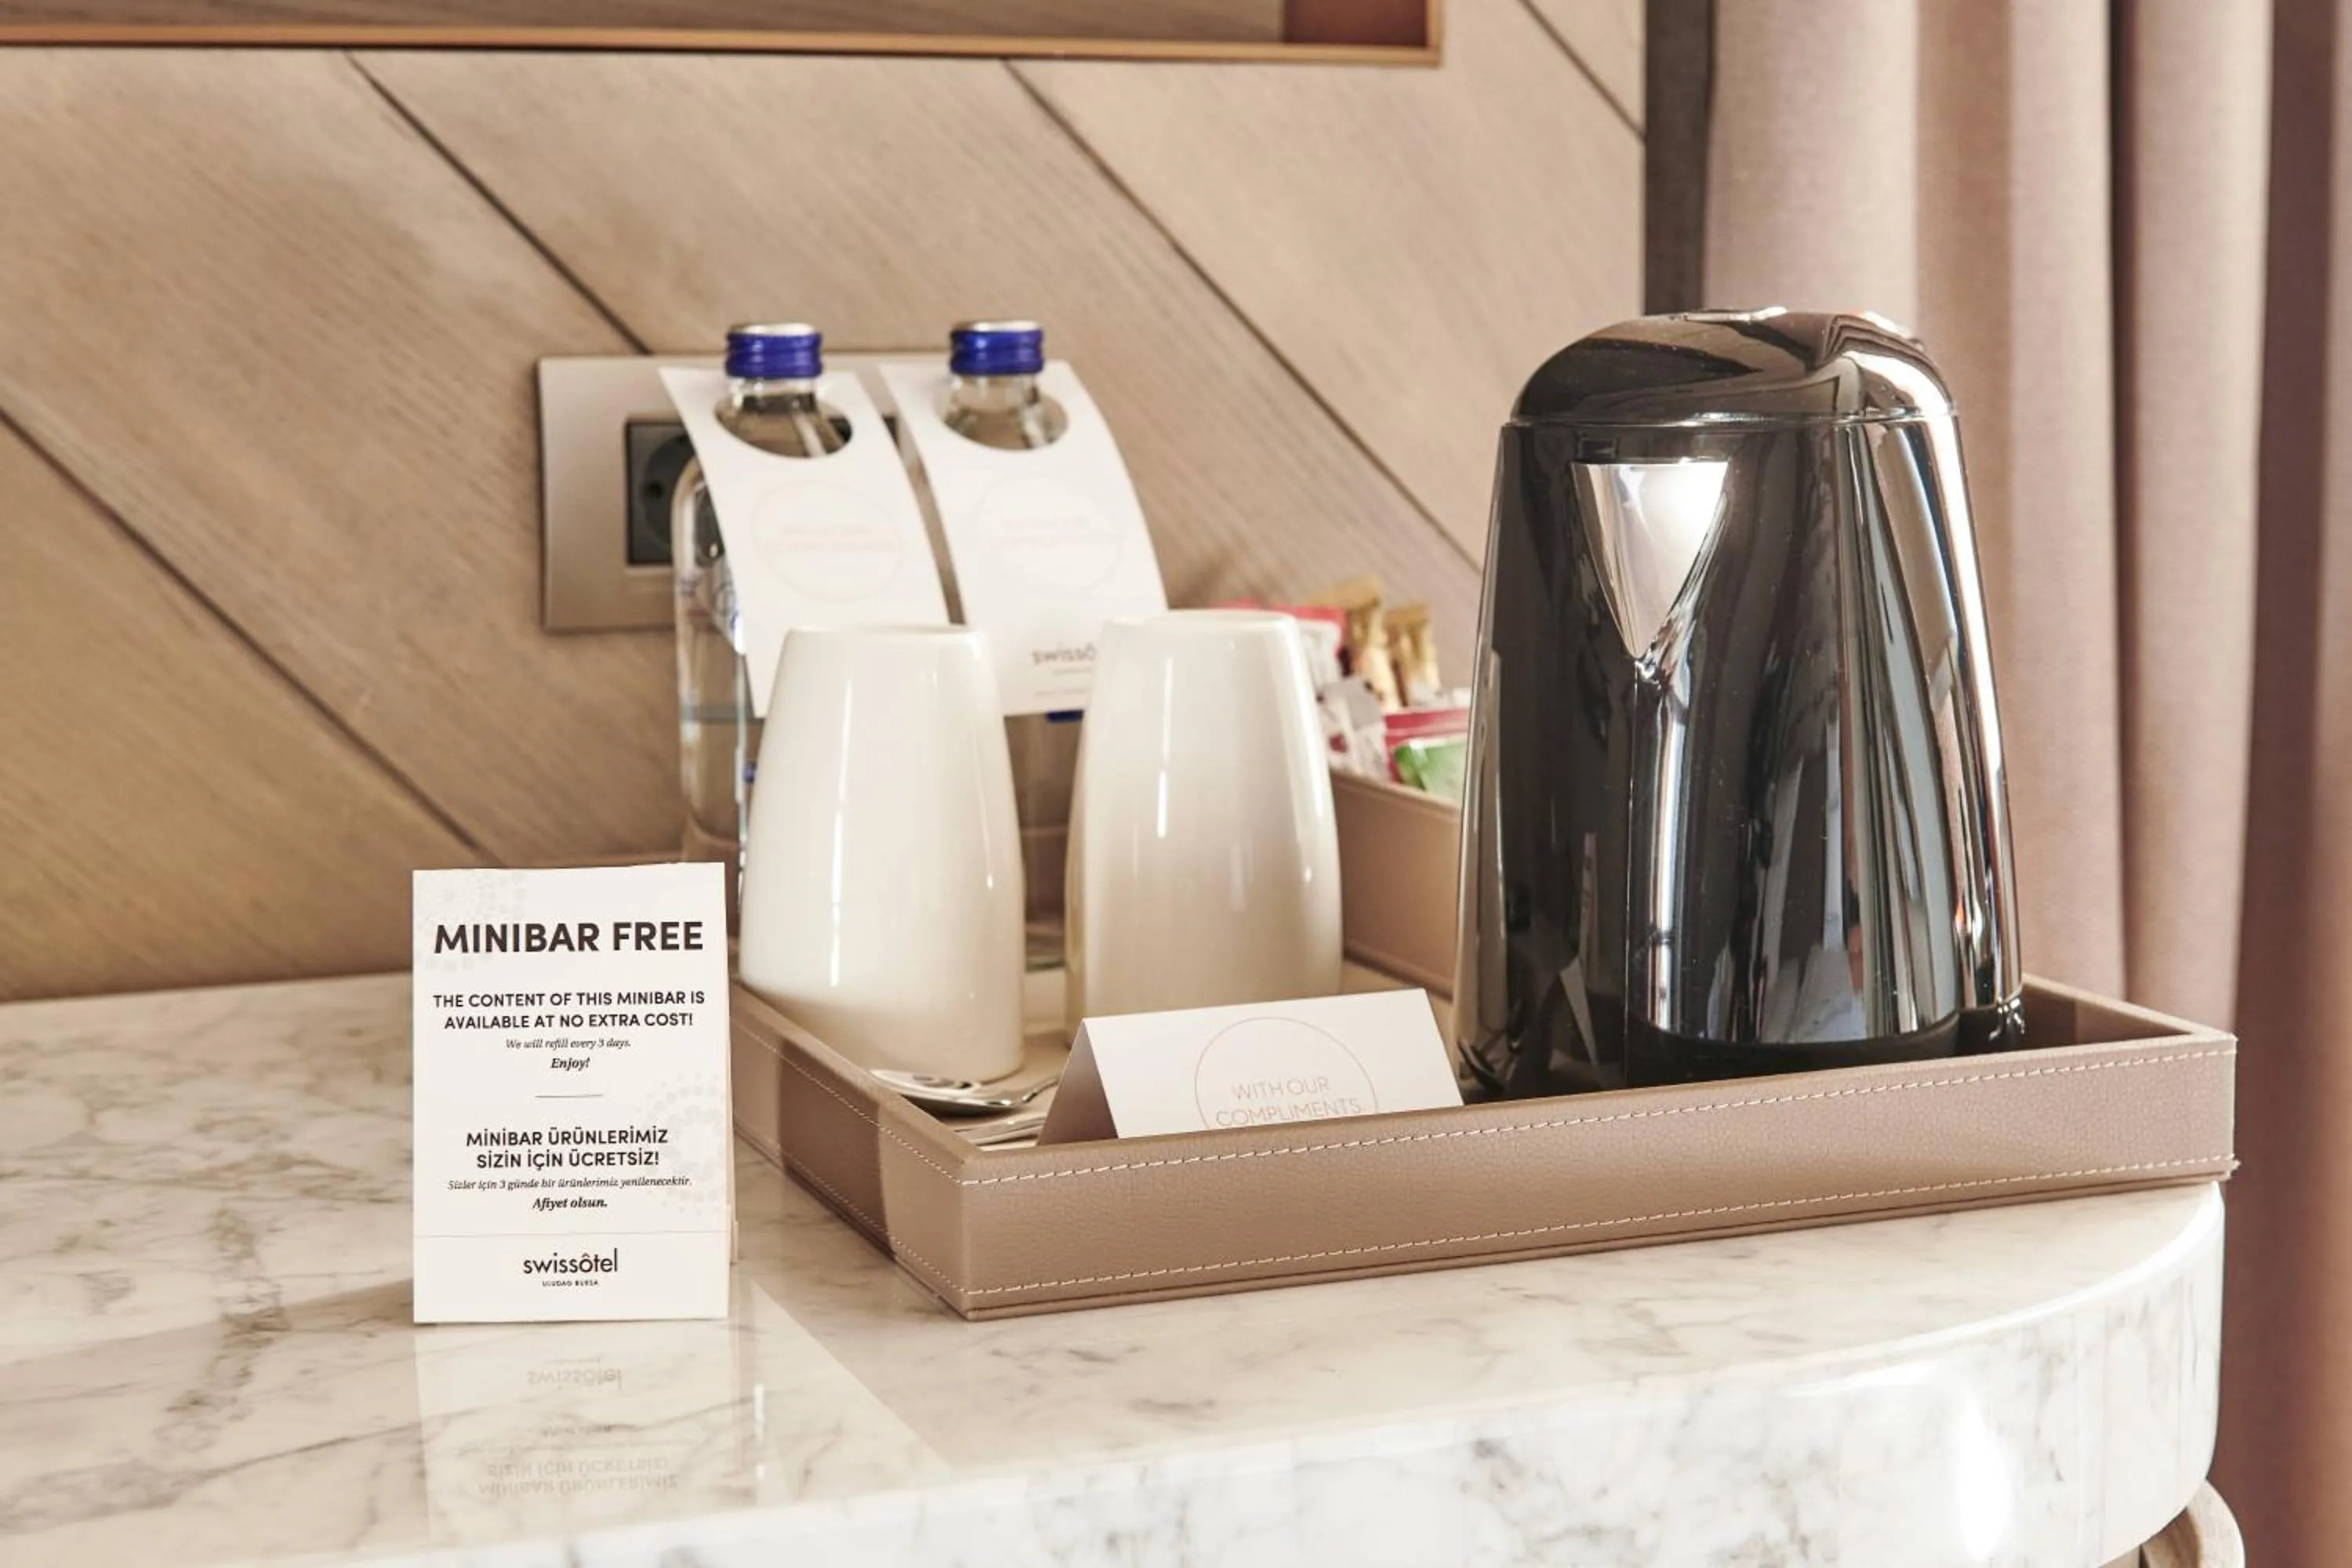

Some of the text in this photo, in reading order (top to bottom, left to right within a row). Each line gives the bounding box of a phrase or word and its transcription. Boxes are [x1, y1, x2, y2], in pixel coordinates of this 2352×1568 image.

[434, 921, 703, 954] MINIBAR FREE
[433, 991, 706, 1008] THE CONTENT OF THIS MINIBAR IS
[444, 1012, 693, 1029] AVAILABLE AT NO EXTRA COST!
[505, 1039, 521, 1049] We
[524, 1038, 543, 1048] will
[545, 1037, 568, 1051] refill
[570, 1039, 597, 1050] every
[606, 1037, 631, 1050] days.
[550, 1057, 590, 1071] Enjoy!
[1231, 1076, 1330, 1100] WITH OUR
[1215, 1098, 1362, 1127] COMPLIMENTS
[466, 1125, 668, 1146] MİNİBAR ÜRÜNLERİMİZ
[477, 1147, 659, 1171] SİZİN İÇİN ÜCRETSİZ!
[448, 1180, 476, 1189] Sizler
[499, 1179, 506, 1189] 3
[507, 1178, 539, 1191] günde
[540, 1178, 557, 1188] bir
[557, 1177, 619, 1189] ürünlerimiz
[532, 1196, 608, 1211] Afiyet olsun.
[523, 1247, 618, 1274] swissôtel
